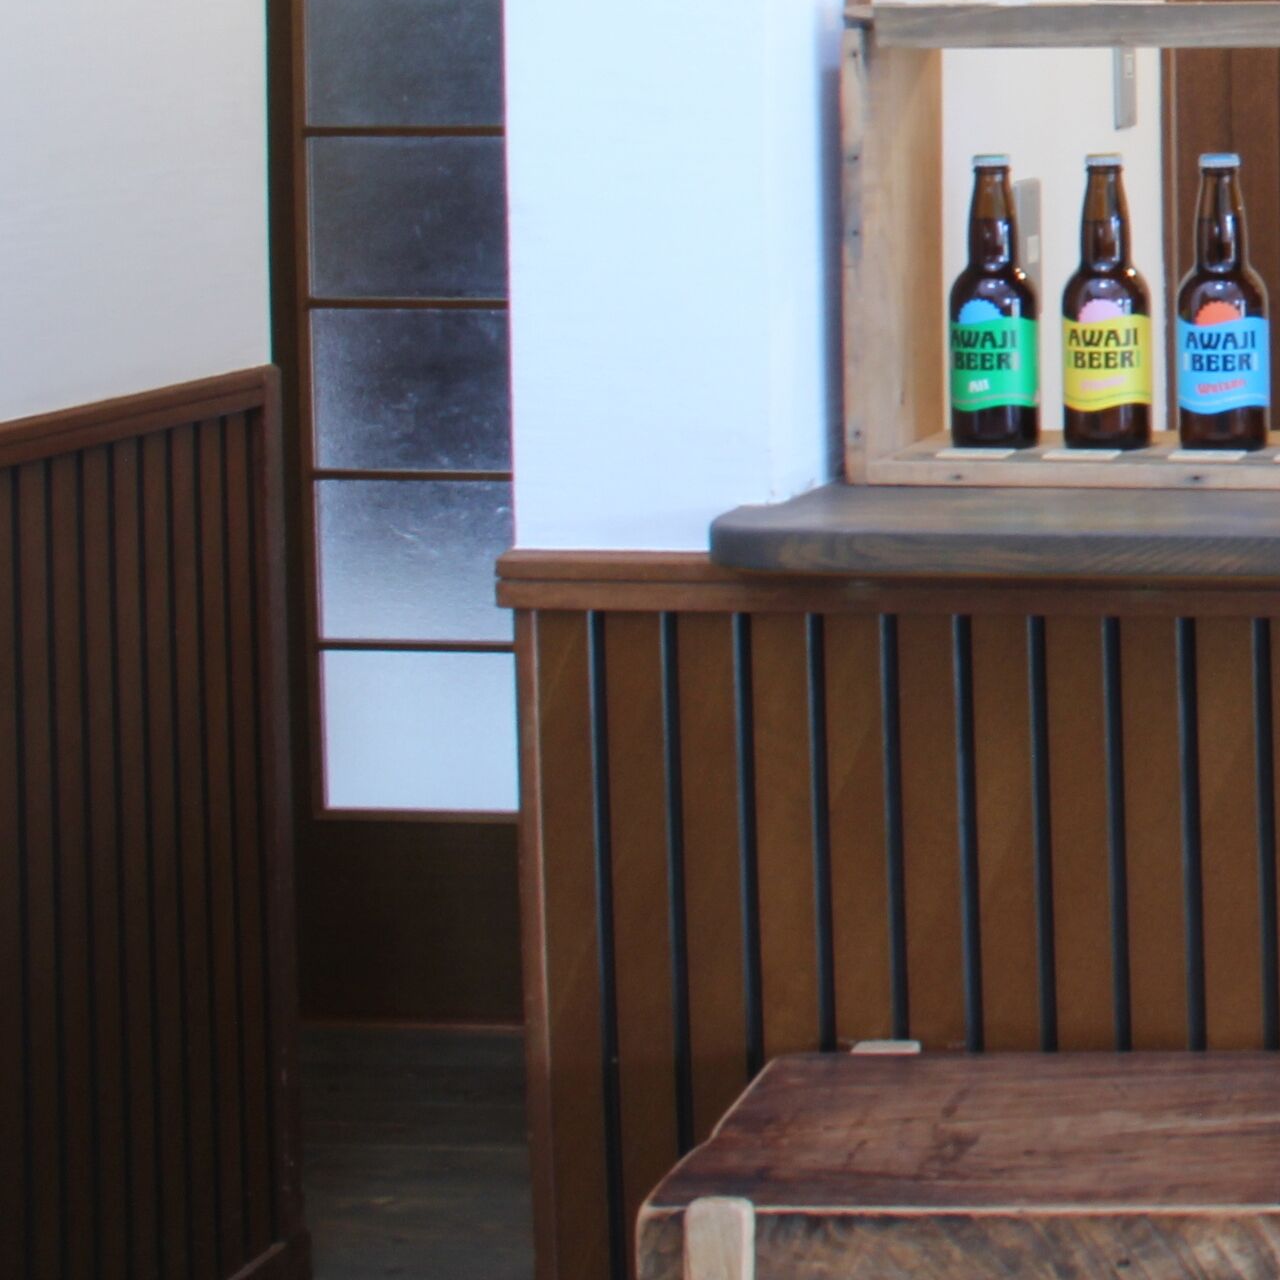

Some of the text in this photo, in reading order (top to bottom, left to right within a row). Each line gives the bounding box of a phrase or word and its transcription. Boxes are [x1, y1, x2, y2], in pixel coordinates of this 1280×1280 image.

[952, 329, 1017, 349] AWAJI
[1068, 327, 1139, 348] AWAJI
[1186, 330, 1256, 350] AWAJI
[954, 351, 1012, 371] BEER
[1074, 350, 1135, 369] BEER
[1191, 353, 1252, 372] BEER
